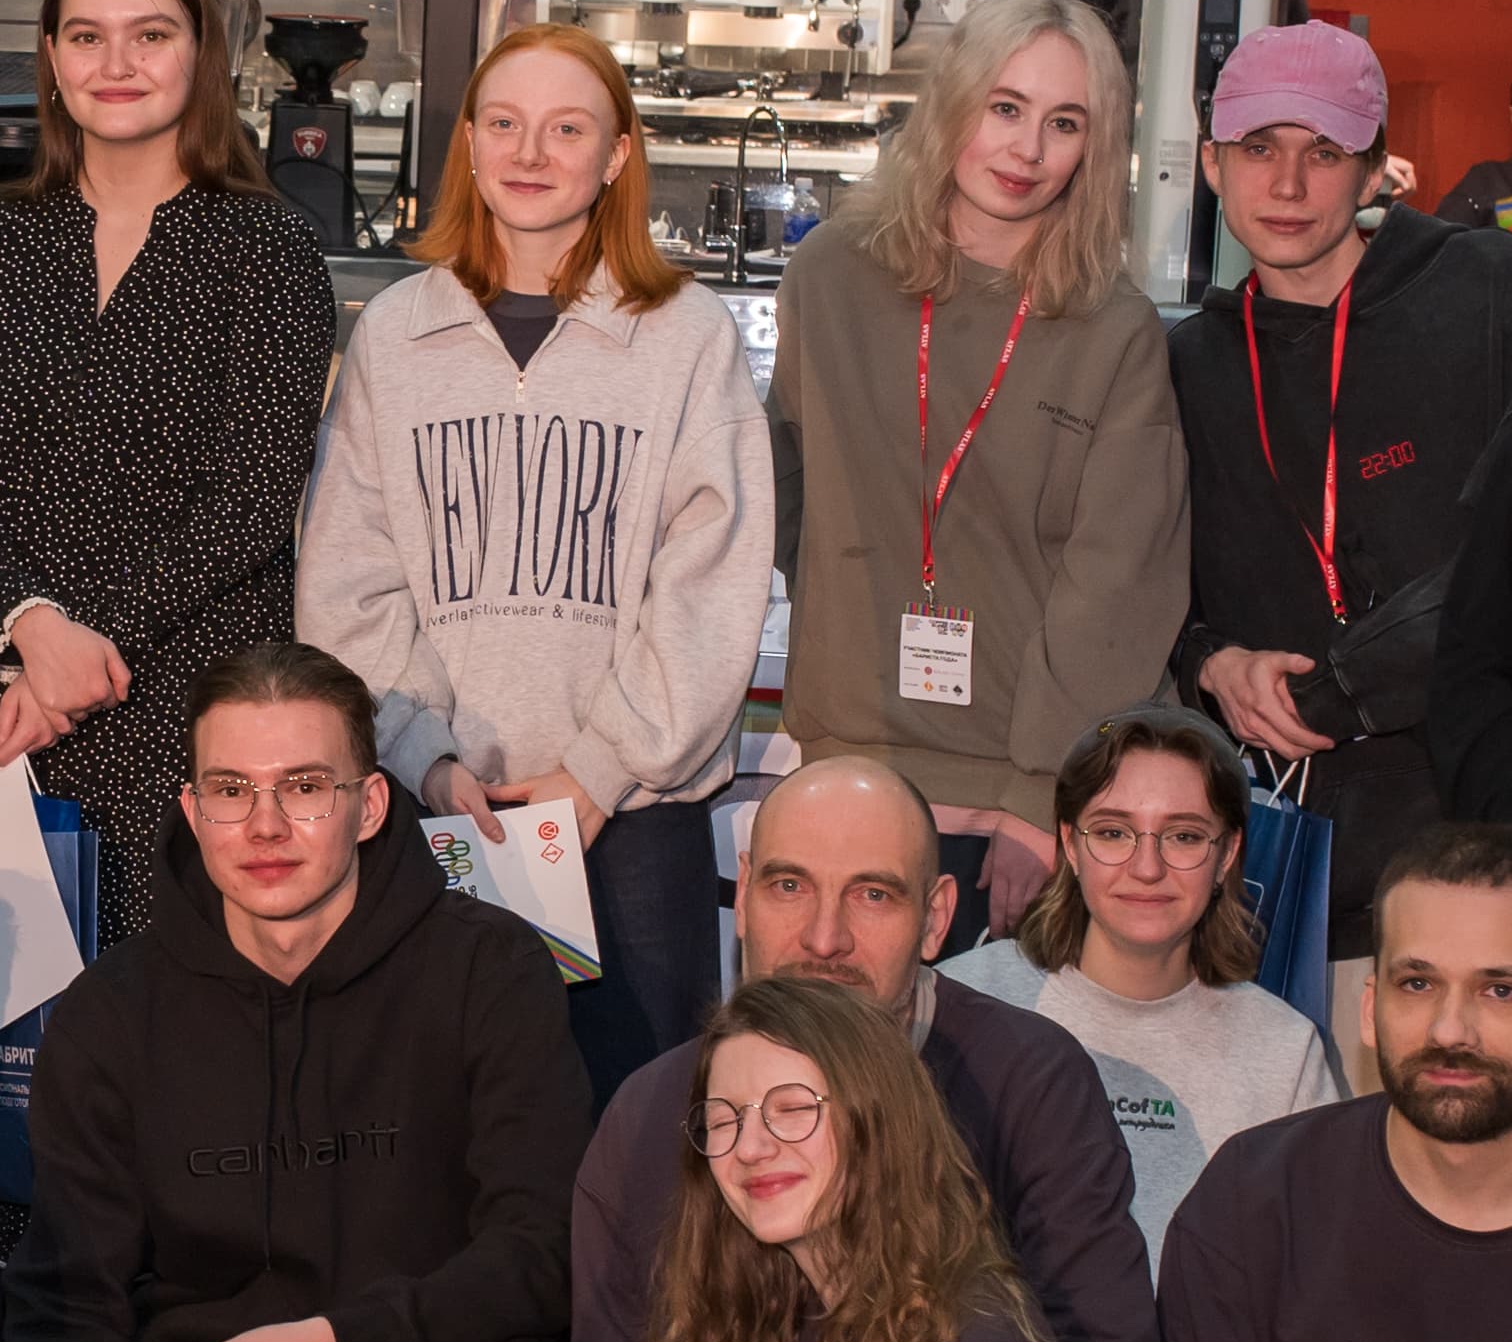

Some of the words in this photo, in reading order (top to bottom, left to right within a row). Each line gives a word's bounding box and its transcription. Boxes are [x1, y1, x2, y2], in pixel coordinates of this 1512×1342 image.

[920, 323, 930, 349] ATLAS
[1001, 338, 1015, 364] ATLAS
[980, 387, 996, 410] ATLAS
[1359, 440, 1416, 480] 22:00
[412, 413, 506, 606] NEW
[509, 414, 644, 609] YORK
[1327, 563, 1337, 590] ATLAS
[474, 604, 546, 617] ctivewear
[552, 605, 564, 619] &
[187, 1122, 401, 1177] carhartt
